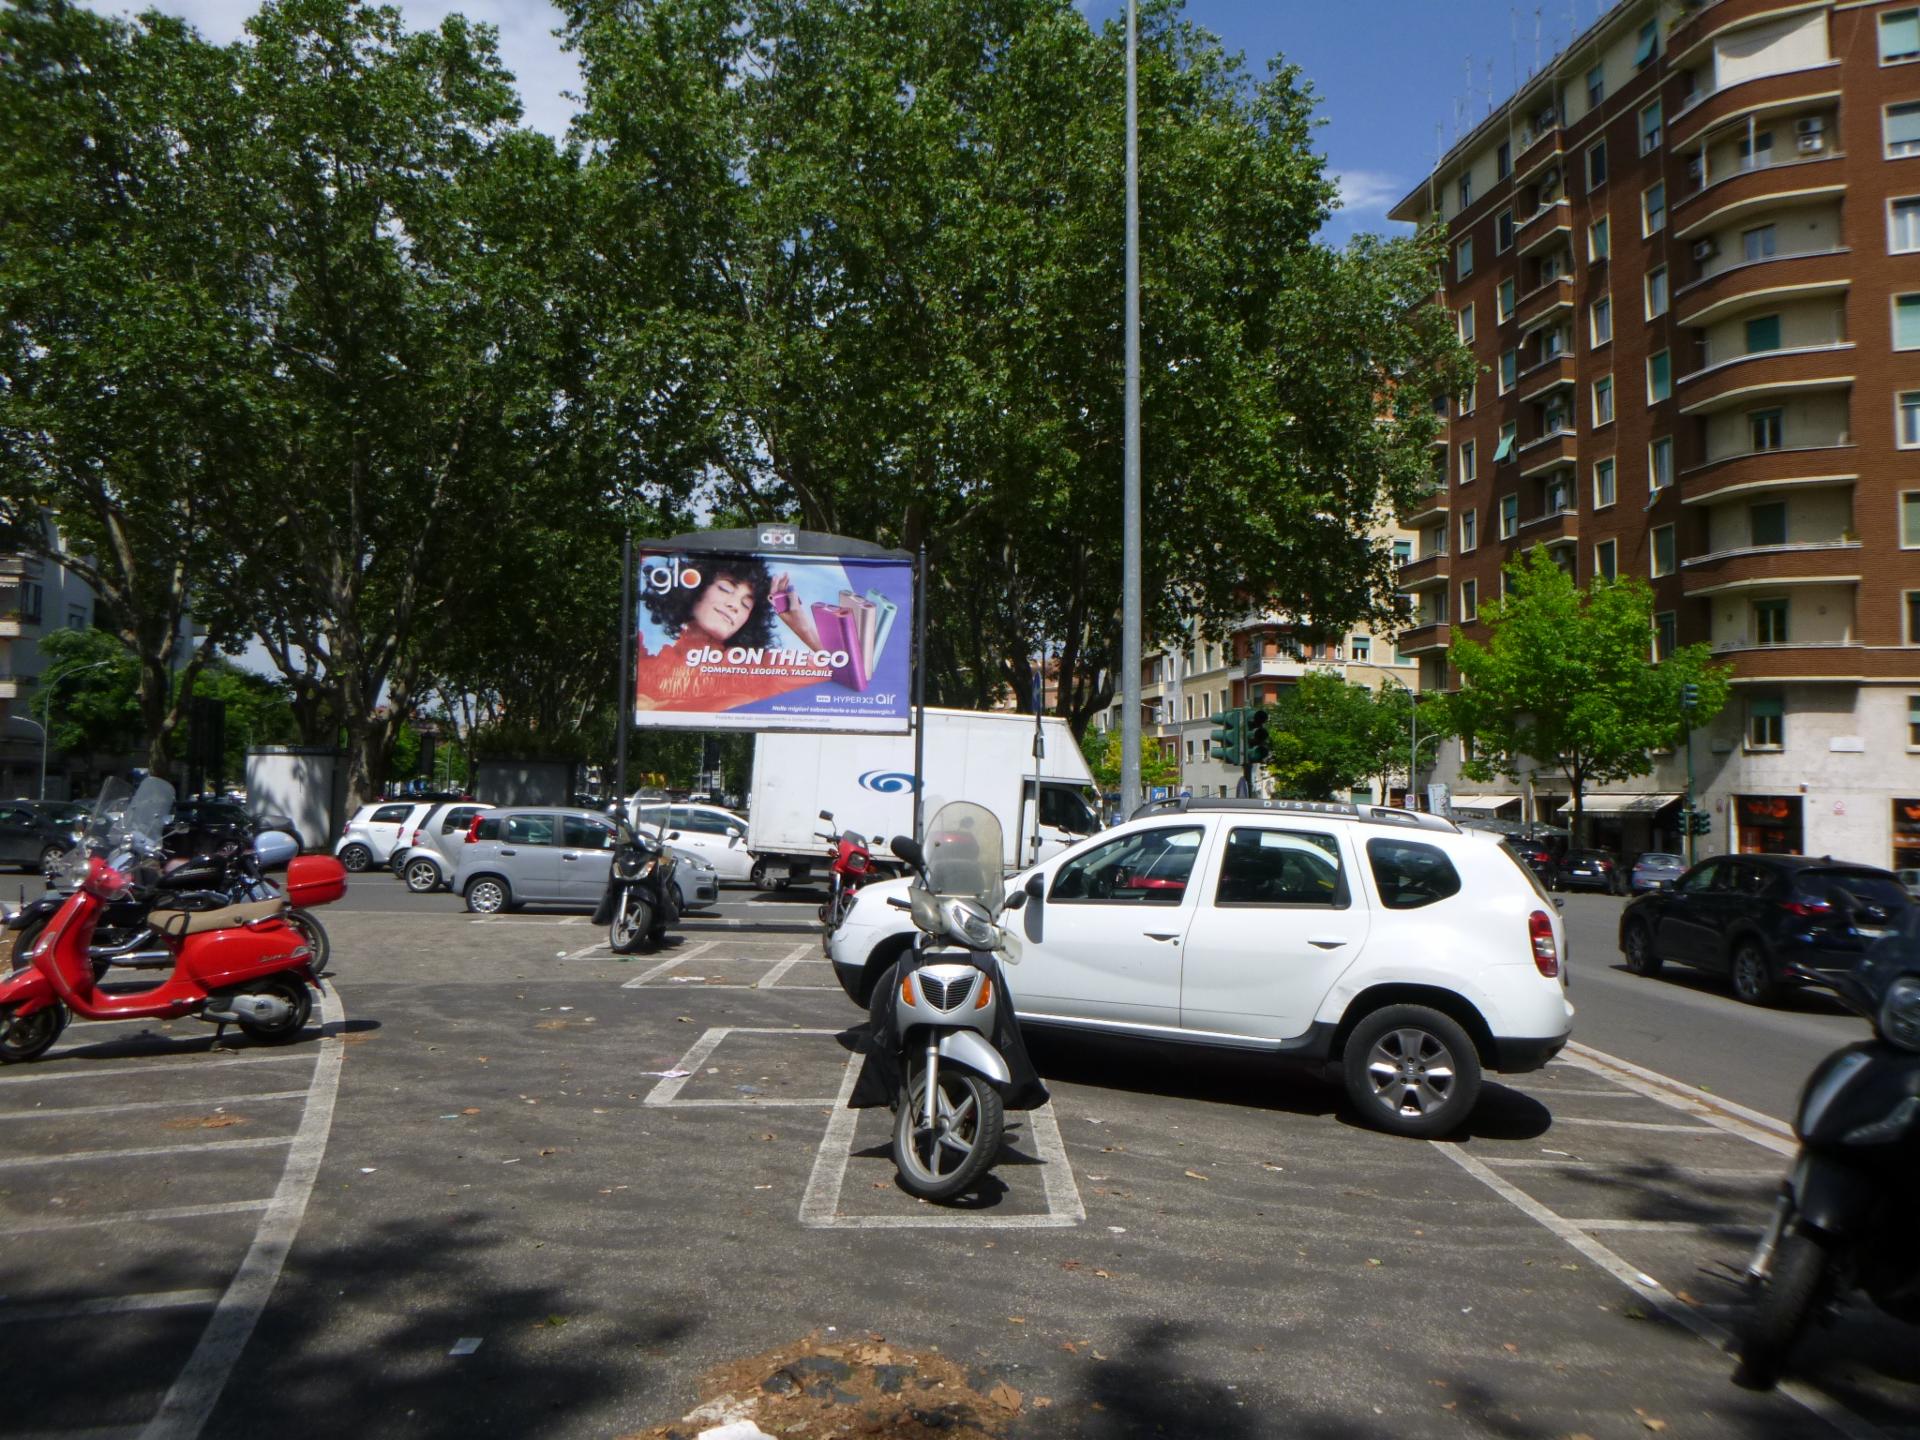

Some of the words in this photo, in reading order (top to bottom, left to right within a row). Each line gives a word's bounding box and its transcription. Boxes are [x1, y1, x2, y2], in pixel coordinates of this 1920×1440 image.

[761, 533, 795, 545] apa
[650, 557, 702, 595] glo
[685, 645, 723, 668] glo
[727, 647, 764, 665] ON
[768, 648, 811, 667] THE
[813, 650, 849, 668] GO
[701, 665, 749, 676] COMPATTO,
[750, 668, 790, 677] LEGGERO,
[791, 669, 833, 678] TASCABILE
[875, 693, 897, 705] air
[1263, 800, 1350, 813] DUSTER
